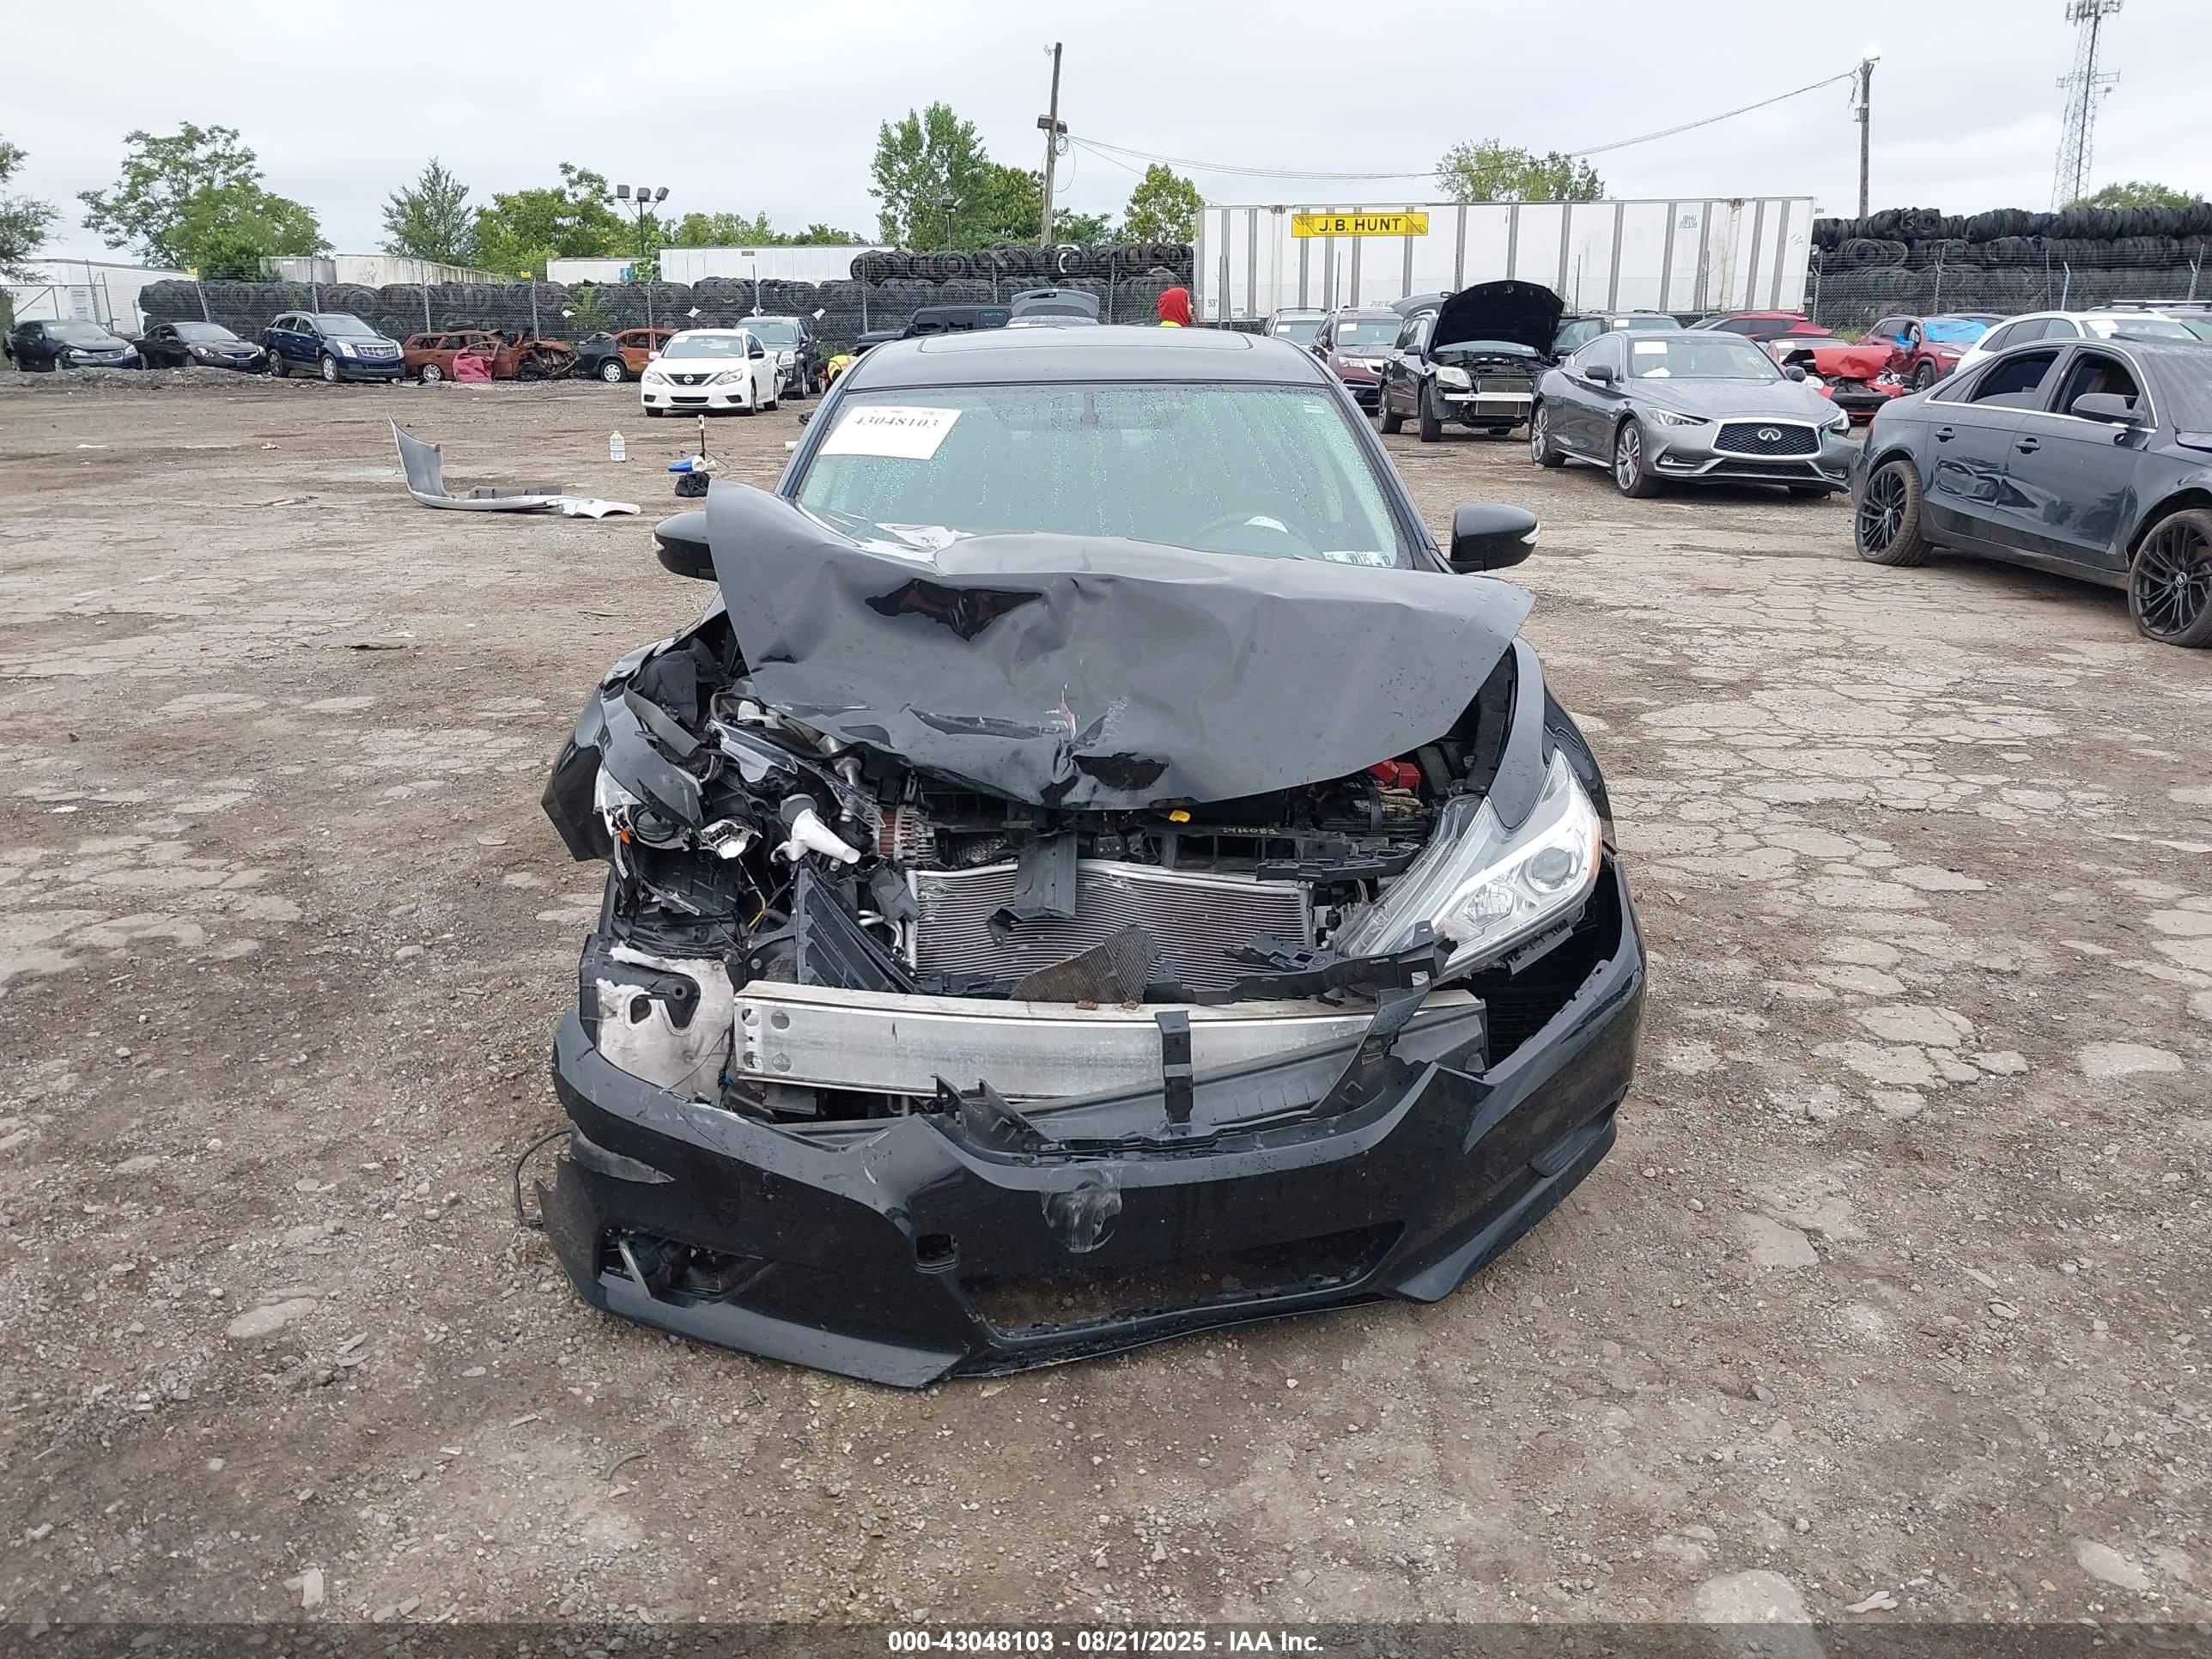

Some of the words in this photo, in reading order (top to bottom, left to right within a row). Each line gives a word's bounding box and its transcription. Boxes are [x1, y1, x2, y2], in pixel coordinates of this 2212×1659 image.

[1319, 219, 1349, 232] J.B.
[1354, 218, 1402, 231] HUNT
[854, 416, 939, 428] 43048103
